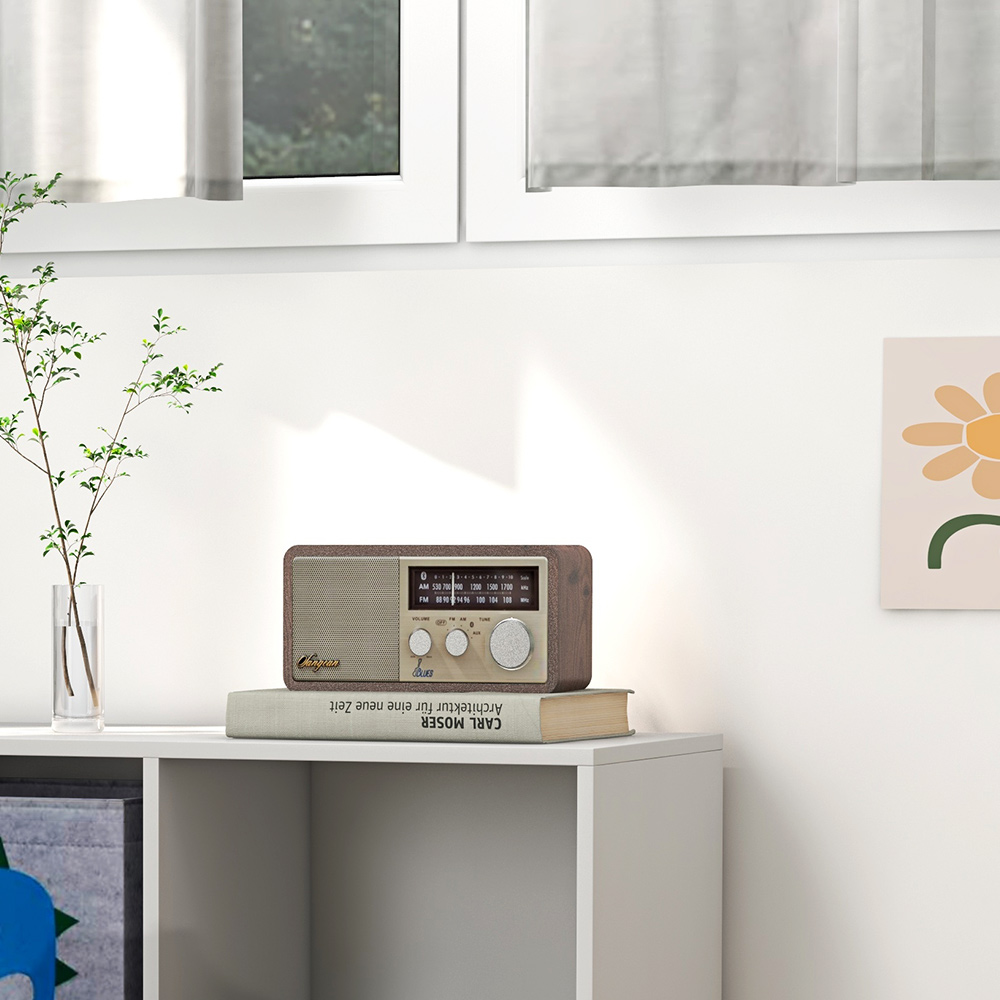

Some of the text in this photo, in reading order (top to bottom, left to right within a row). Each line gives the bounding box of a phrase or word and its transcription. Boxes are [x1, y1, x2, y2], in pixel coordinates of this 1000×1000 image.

[432, 583, 441, 591] 530
[442, 583, 451, 591] 700
[470, 583, 482, 591] 1200
[486, 583, 498, 591] 1500
[500, 583, 513, 591] 1700
[436, 596, 442, 604] 88
[442, 596, 449, 604] 90
[456, 596, 463, 604] 94
[463, 596, 471, 604] 96
[476, 596, 485, 604] 100
[488, 596, 498, 604] 104
[503, 596, 512, 604] 108
[329, 700, 503, 715] Architektur für eine neue Zeit
[421, 716, 502, 730] CARL MOSER
